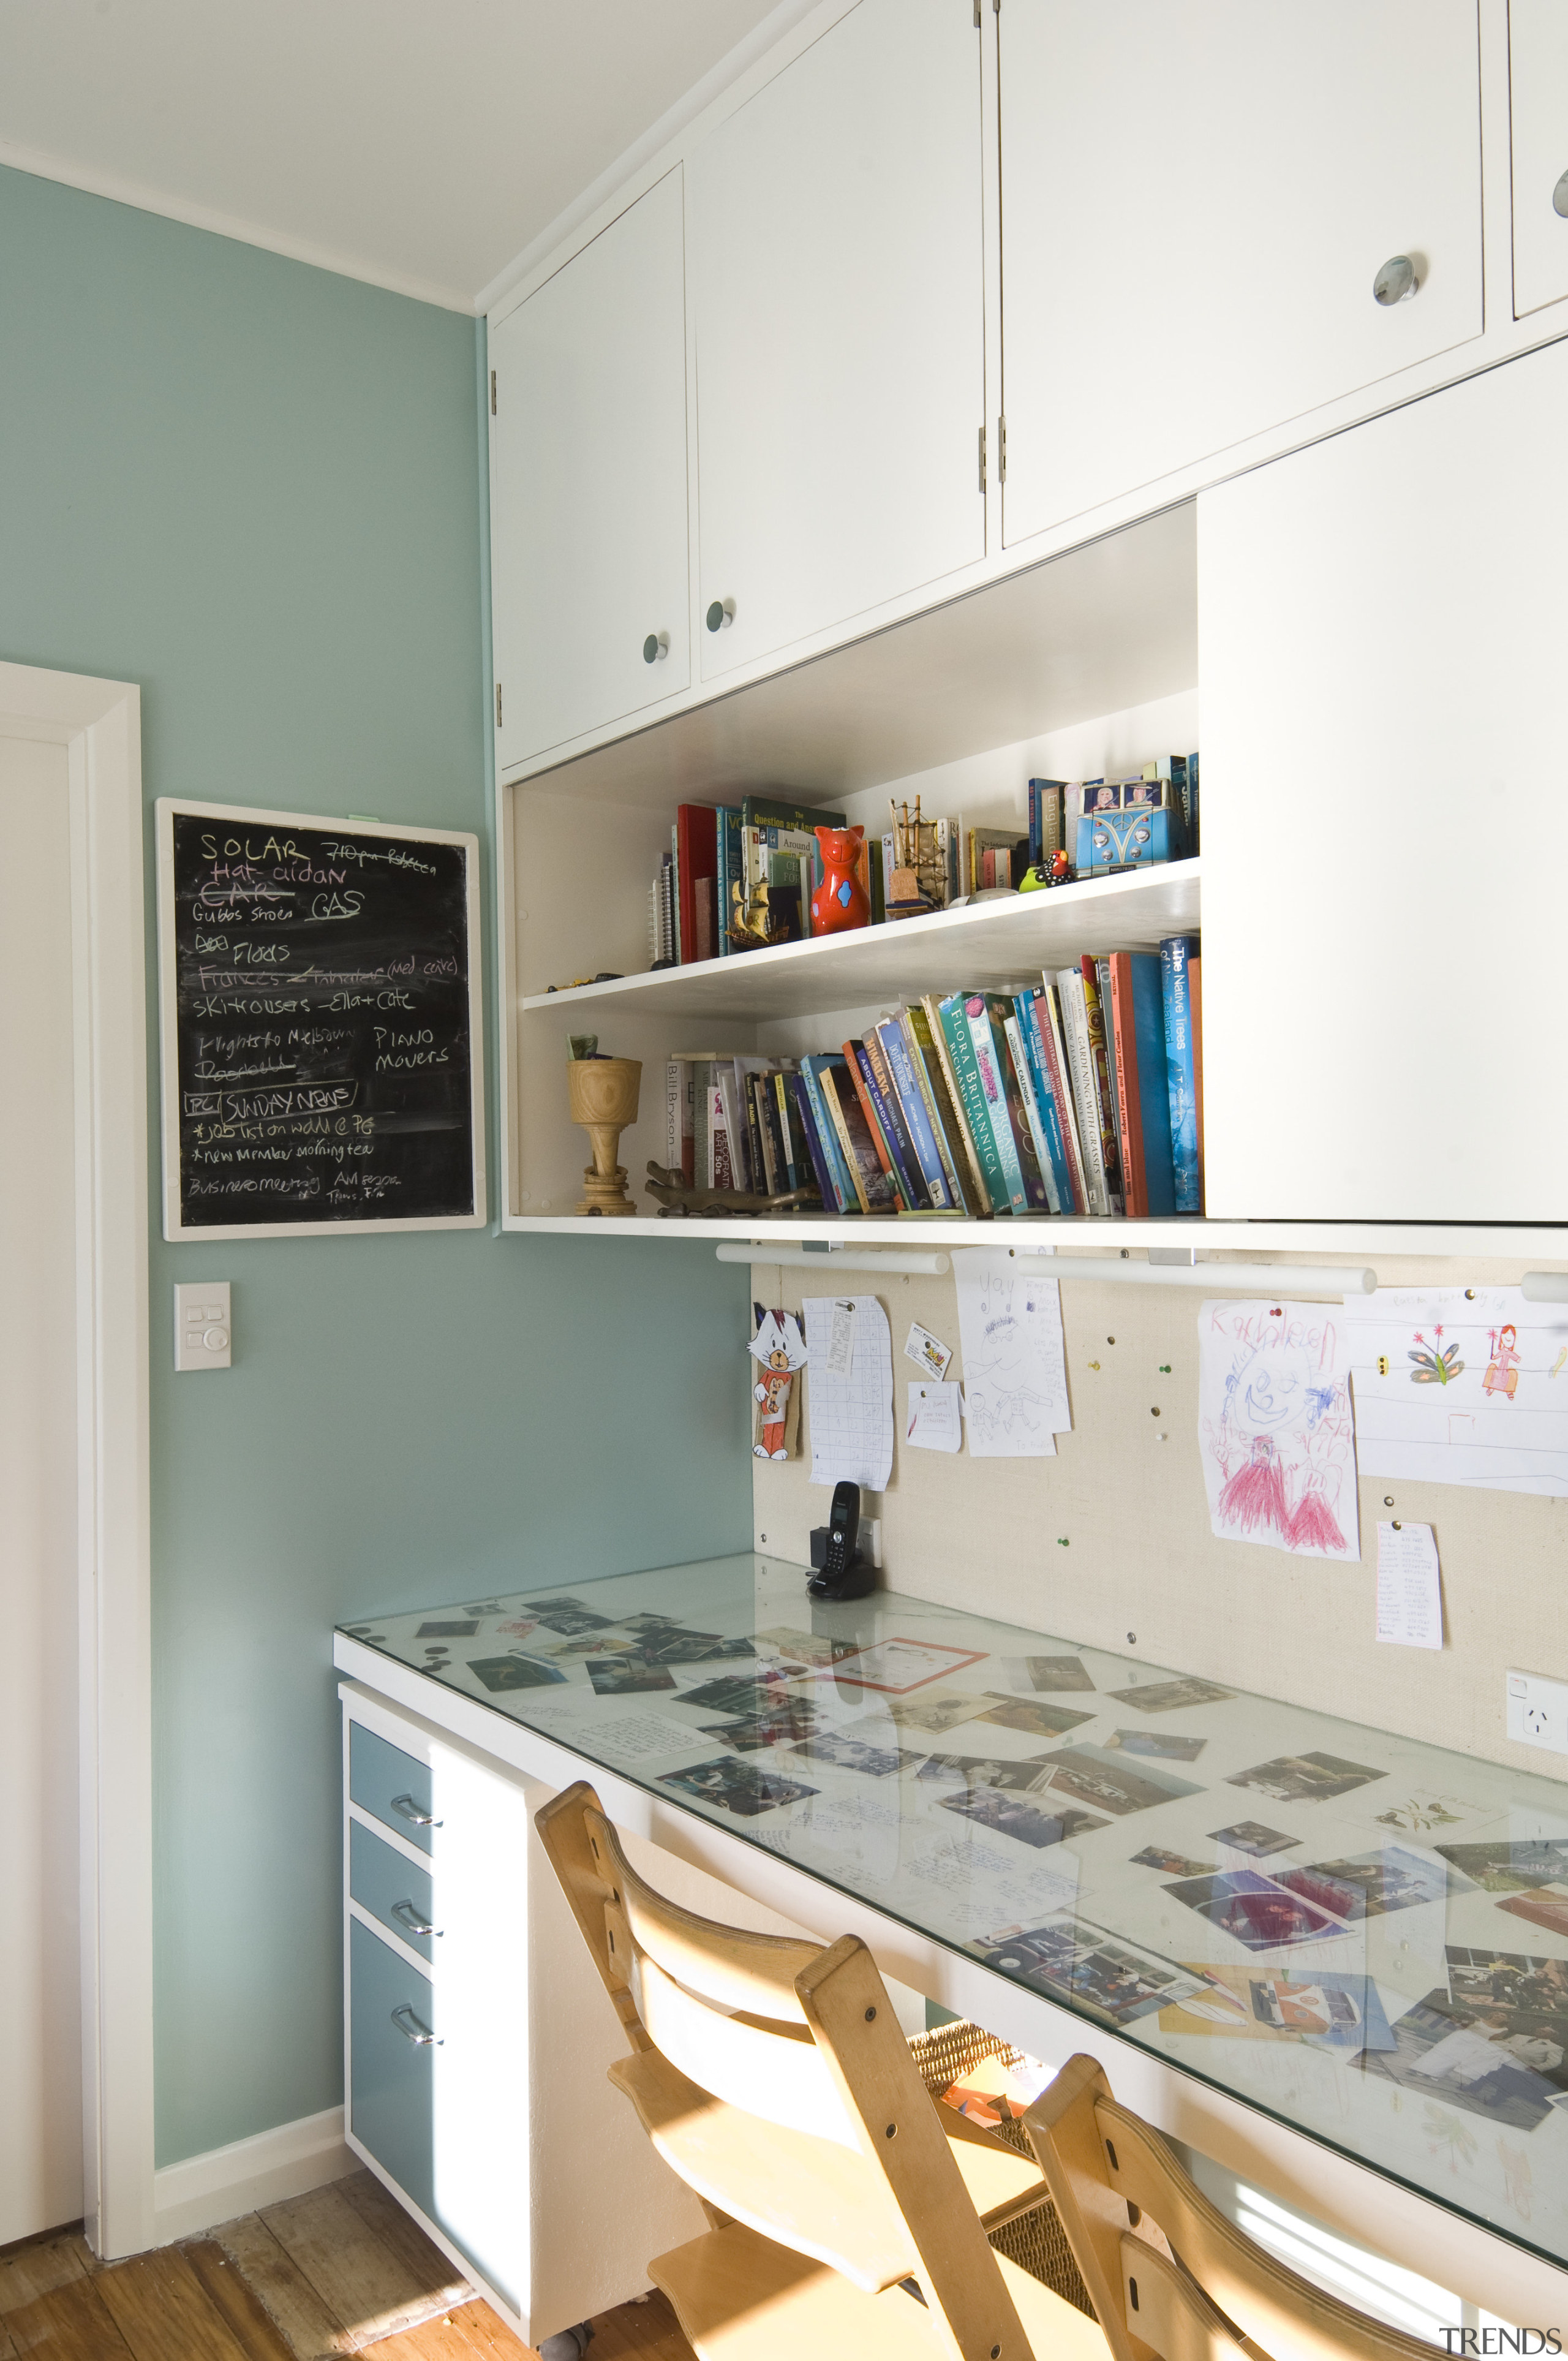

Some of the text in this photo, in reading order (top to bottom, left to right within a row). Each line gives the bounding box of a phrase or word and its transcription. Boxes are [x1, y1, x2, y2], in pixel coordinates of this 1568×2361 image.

[755, 814, 785, 828] Question
[786, 822, 799, 830] and
[202, 834, 311, 861] SOLAR
[784, 839, 810, 851] Around
[311, 890, 365, 920] GAS
[1172, 946, 1185, 973] The
[1160, 950, 1174, 1044] of New Zealand
[1174, 974, 1186, 1014] Native
[374, 1026, 434, 1049] PIANO
[1030, 1011, 1040, 1035] COMPLETE
[1042, 1013, 1051, 1029] THE
[1175, 1016, 1188, 1051] Trees
[1035, 1035, 1043, 1049] NEW
[1036, 1049, 1048, 1069] ZEALAND
[1046, 1029, 1060, 1075] ILLUSTRATED
[668, 1066, 677, 1088] Bill
[846, 1056, 867, 1103] planted
[1008, 1033, 1021, 1070] GARDENING
[1018, 1069, 1031, 1106] CALENDAR
[1069, 1042, 1079, 1084] ZEALAND
[1077, 1035, 1091, 1101] GARDENING
[861, 1058, 891, 1131] ABOUT CARDIFF
[865, 1036, 906, 1149] HIMALAYA MICHAEL PALIN
[949, 1042, 981, 1151] RICHARD MABEY
[951, 1008, 971, 1065] FLORA
[965, 1070, 997, 1176] BRITANNICA
[1041, 1070, 1052, 1095] GARDENER
[1049, 1071, 1058, 1098] OLIVER
[1055, 1075, 1066, 1110] HISTORY
[226, 1092, 293, 1119] SUNDAY
[296, 1087, 350, 1110] NEWS
[668, 1092, 677, 1145] Bryson
[826, 1079, 835, 1098] Samuel
[841, 1135, 851, 1156] Francis
[909, 1048, 949, 1173] EXTINCT BIRDS OF NEW ZEALAND
[1061, 1110, 1068, 1122] OF
[1076, 1084, 1084, 1119] NATIVE
[1085, 1101, 1096, 1130] WITH
[242, 1120, 264, 1139] list
[989, 1106, 1011, 1179] GARDENING
[997, 1101, 1020, 1177] ORGANIC
[1079, 1119, 1088, 1153] PLANTS
[347, 1144, 374, 1155] tea
[1067, 1137, 1081, 1191] COUNTRYSIDE
[1088, 1130, 1101, 1175] GRASSES
